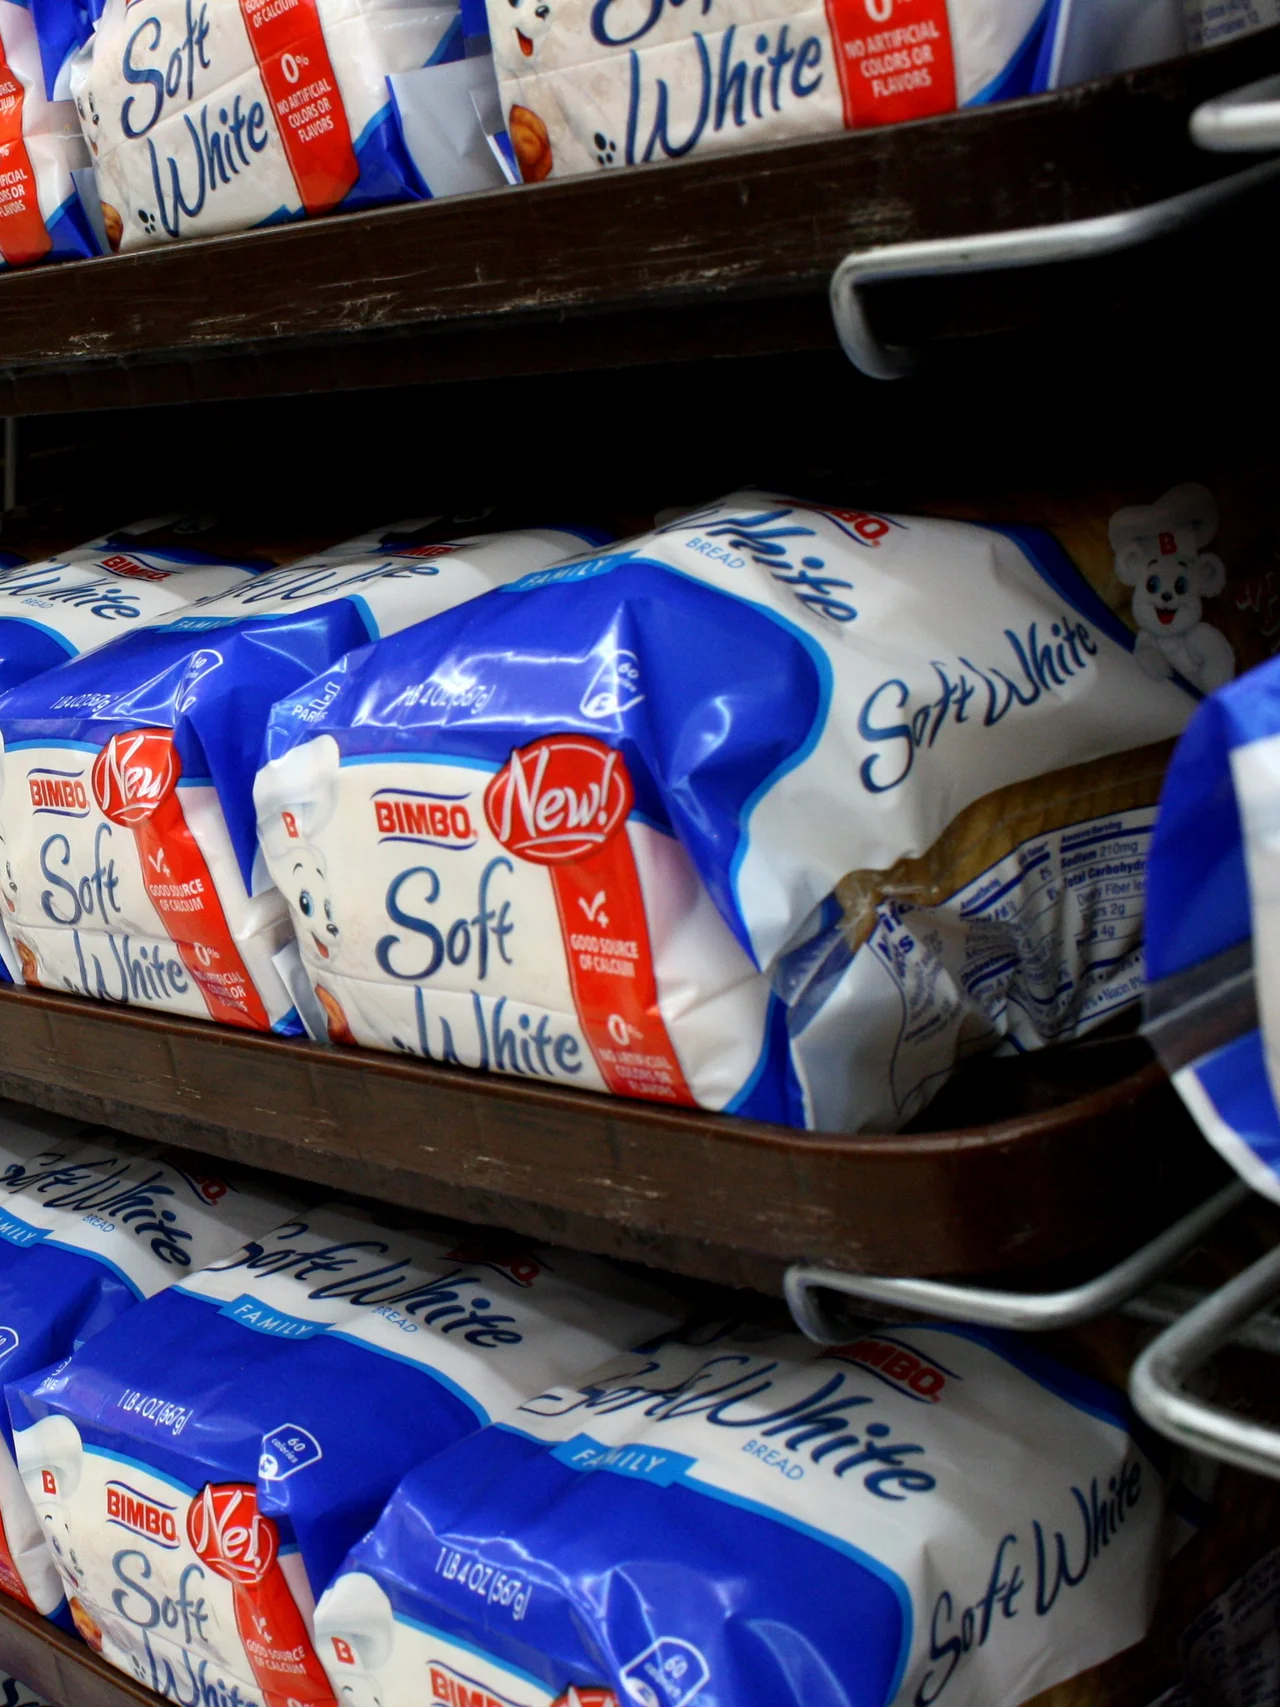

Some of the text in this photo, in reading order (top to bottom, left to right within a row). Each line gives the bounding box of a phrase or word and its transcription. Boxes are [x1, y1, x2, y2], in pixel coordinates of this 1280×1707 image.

[866, 19, 940, 54] ARTIFICIAL
[281, 53, 310, 84] 0%
[860, 44, 934, 78] COLORS OR
[276, 78, 332, 116] NO ARTIFICIAL
[625, 24, 823, 165] White
[871, 67, 932, 98] FLAVORS
[288, 97, 332, 129] COLORS OR
[298, 115, 334, 143] FLAVORS
[147, 93, 268, 238] White
[11, 183, 26, 198] OR
[685, 537, 746, 570] BREAD
[958, 616, 1099, 728] White
[857, 658, 977, 793] Soft
[28, 778, 91, 810] BIMBO
[500, 746, 617, 842] New!
[374, 800, 472, 840] BIMBO
[40, 822, 121, 925] Soft
[170, 878, 205, 897] SOURCE
[375, 857, 514, 980] Soft
[71, 927, 189, 1003] White
[193, 941, 220, 967] 0%
[571, 933, 640, 960] GOOD SOURCE
[579, 954, 593, 971] OF
[414, 985, 583, 1076] White
[43, 1159, 193, 1268] White
[81, 1212, 116, 1234] BREAD
[233, 1302, 314, 1337] FAMILY
[308, 1256, 524, 1349] White
[374, 1305, 419, 1335] BREAD
[117, 1389, 195, 1436] 1 LB 4 OZ (567g)
[656, 1361, 937, 1502] White
[271, 1435, 299, 1464] calories
[287, 1437, 305, 1453] 60
[570, 1447, 668, 1475] FAMILY
[741, 1438, 805, 1483] BREAD
[106, 1487, 179, 1541] BIMBO
[1031, 1461, 1143, 1616] White
[111, 1548, 210, 1645] Soft
[435, 1547, 534, 1620] 1 LB 4 OZ (567g)
